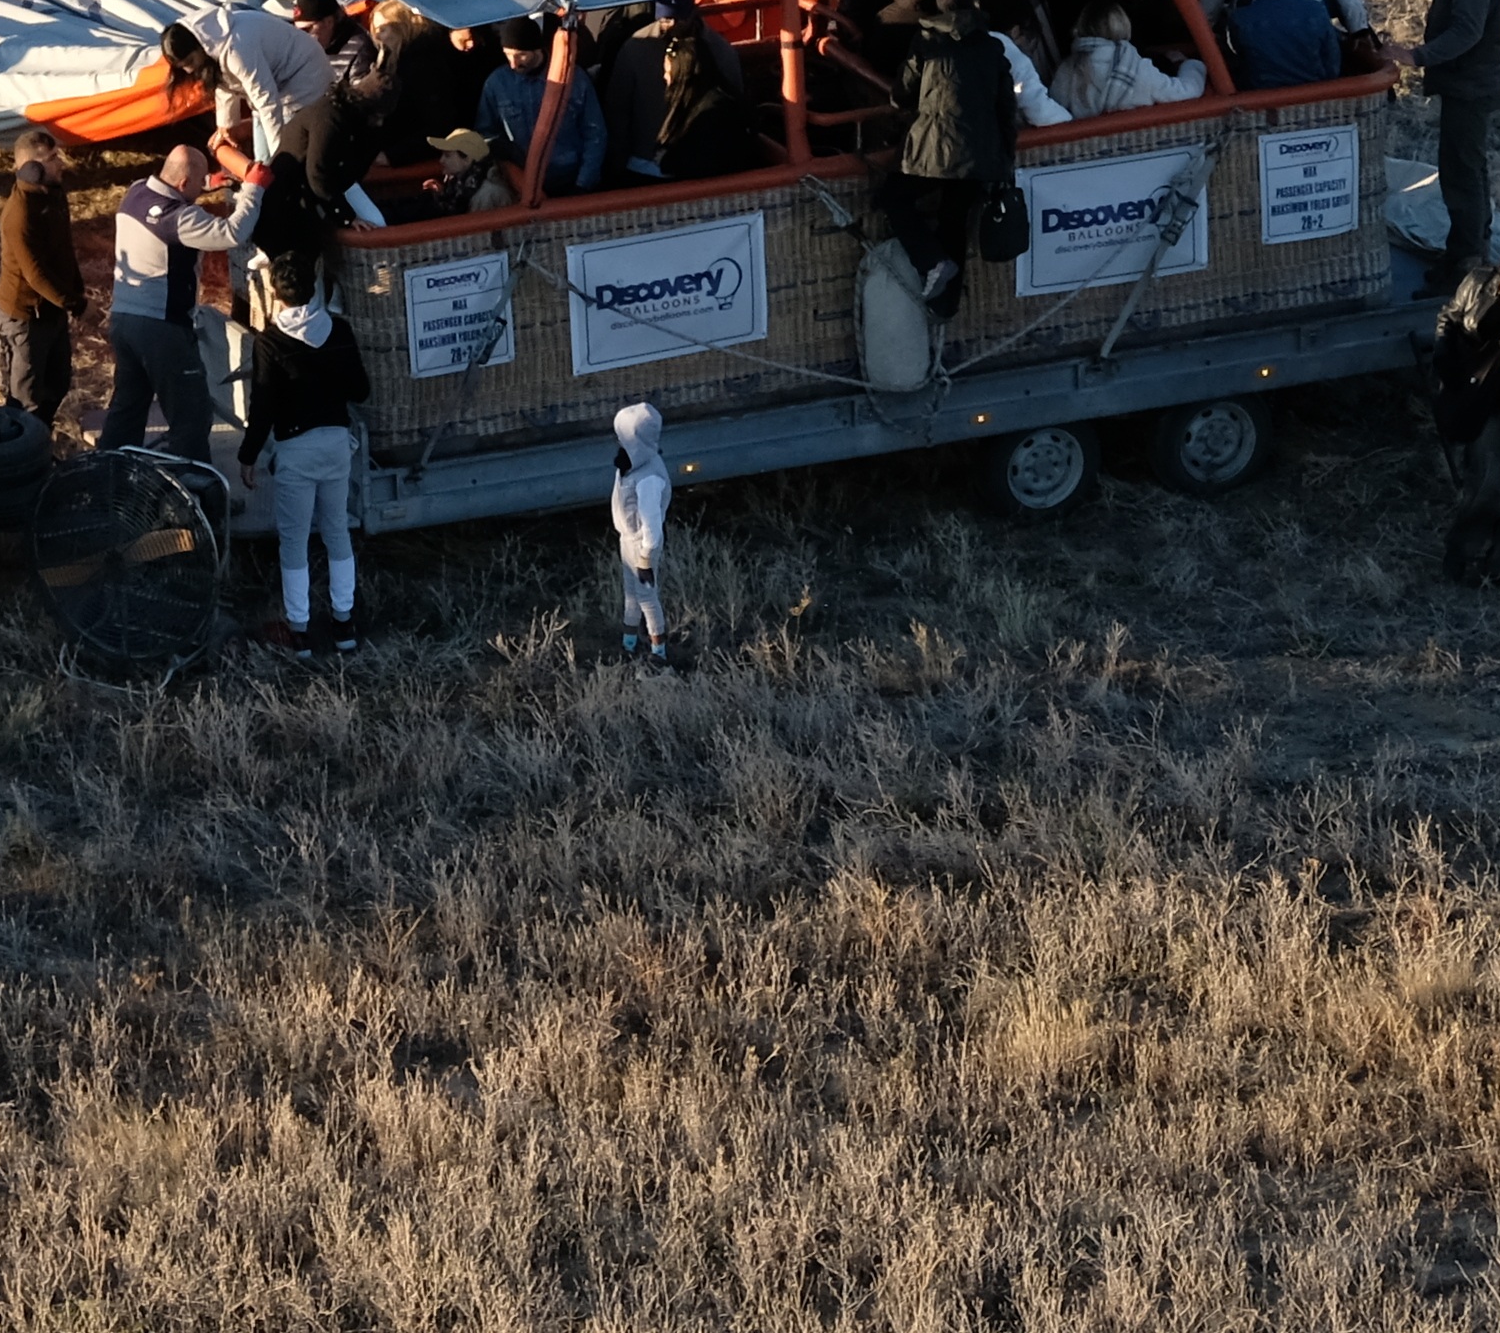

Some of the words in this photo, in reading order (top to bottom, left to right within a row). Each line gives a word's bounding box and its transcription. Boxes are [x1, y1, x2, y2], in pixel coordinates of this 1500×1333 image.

[1279, 139, 1331, 155] Discovery
[427, 272, 480, 289] Discovery
[595, 267, 724, 311] Discovery
[452, 299, 467, 311] MAX
[623, 295, 702, 316] BALLOONS
[422, 315, 462, 332] PASSENGER
